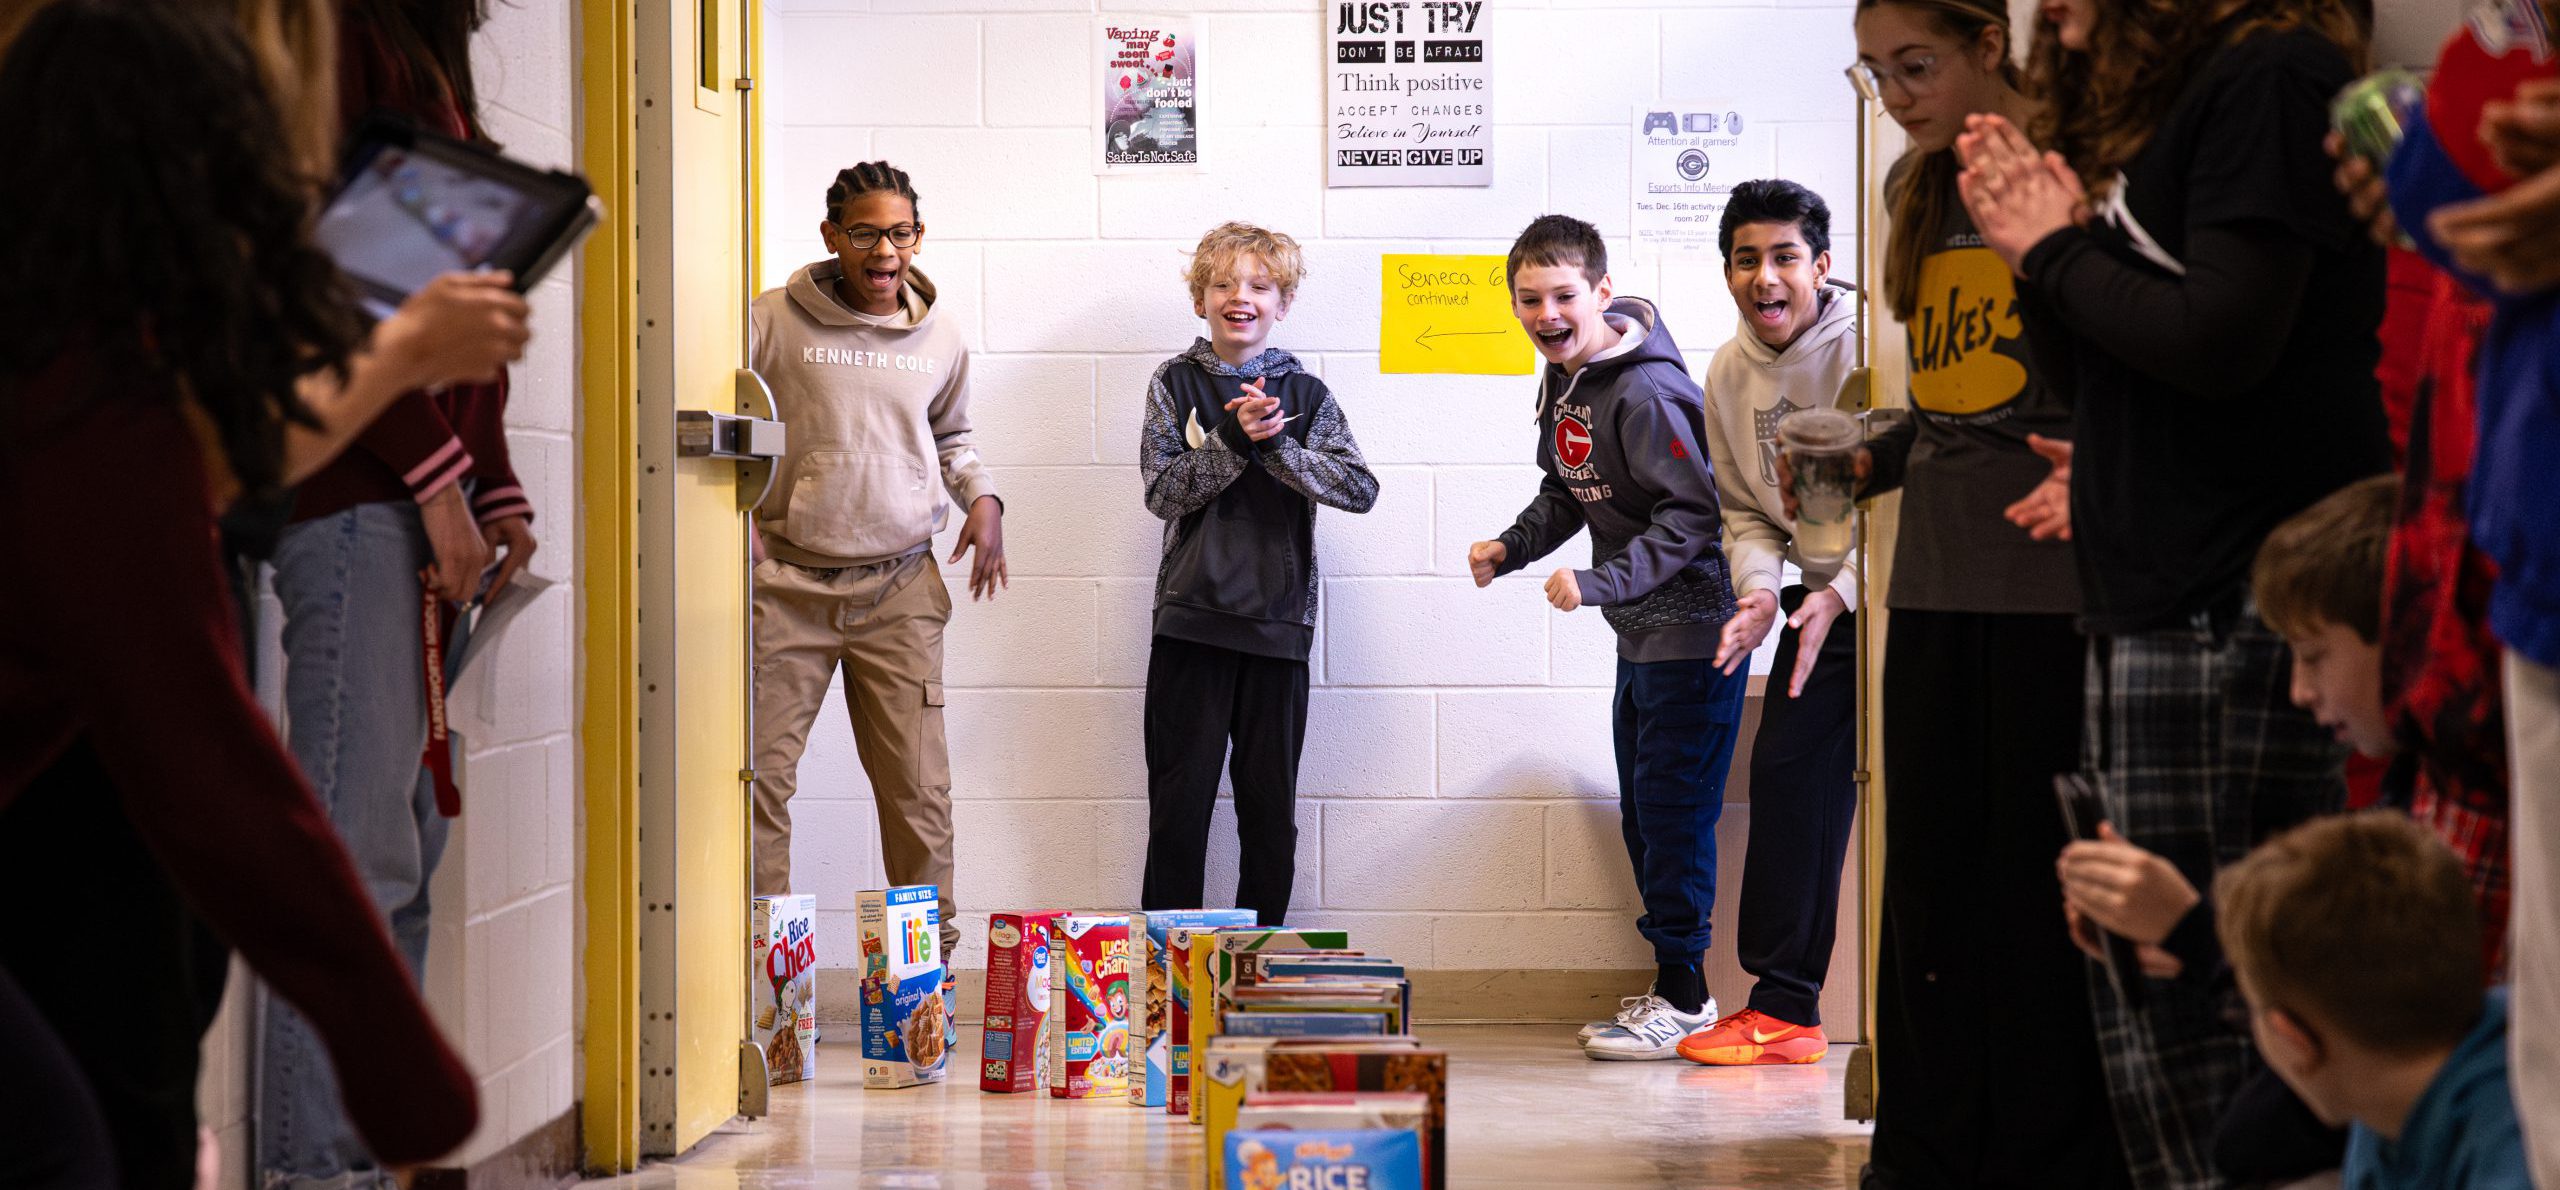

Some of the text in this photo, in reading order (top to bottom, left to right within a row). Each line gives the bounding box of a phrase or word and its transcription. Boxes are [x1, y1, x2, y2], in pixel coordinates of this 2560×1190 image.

[1337, 1, 1482, 34] JUST TRY
[1105, 27, 1160, 42] Vaping
[1126, 41, 1150, 50] may
[1339, 46, 1481, 58] DON'T BE AFRAID
[1337, 73, 1482, 96] Think positive
[1147, 88, 1192, 98] don't be
[1154, 98, 1192, 108] fooled
[1337, 105, 1482, 116] ACCEPT CHANGES
[1337, 122, 1482, 143] Believe in Yourself
[1648, 136, 1738, 148] Attention all gamers!
[1339, 149, 1482, 165] NEVER GIVE UP
[1648, 183, 1733, 192] Esports Info Meetin
[1690, 203, 1715, 211] activity
[1398, 264, 1504, 289] Seneca 6
[1407, 291, 1469, 306] continued
[803, 347, 935, 373] KENNETH COLE
[895, 889, 932, 903] FAMILY SIZE
[787, 917, 809, 945] Rice
[753, 938, 766, 949] ex
[901, 917, 931, 965] life
[1100, 938, 1129, 962] Luck
[766, 932, 816, 984] Chex
[1244, 962, 1252, 973] 8
[895, 987, 920, 1006] original
[798, 1017, 813, 1031] FREE
[1068, 1037, 1094, 1047] LIMITED
[1071, 1046, 1092, 1054] EDITION
[1288, 1165, 1368, 1190] RICE
